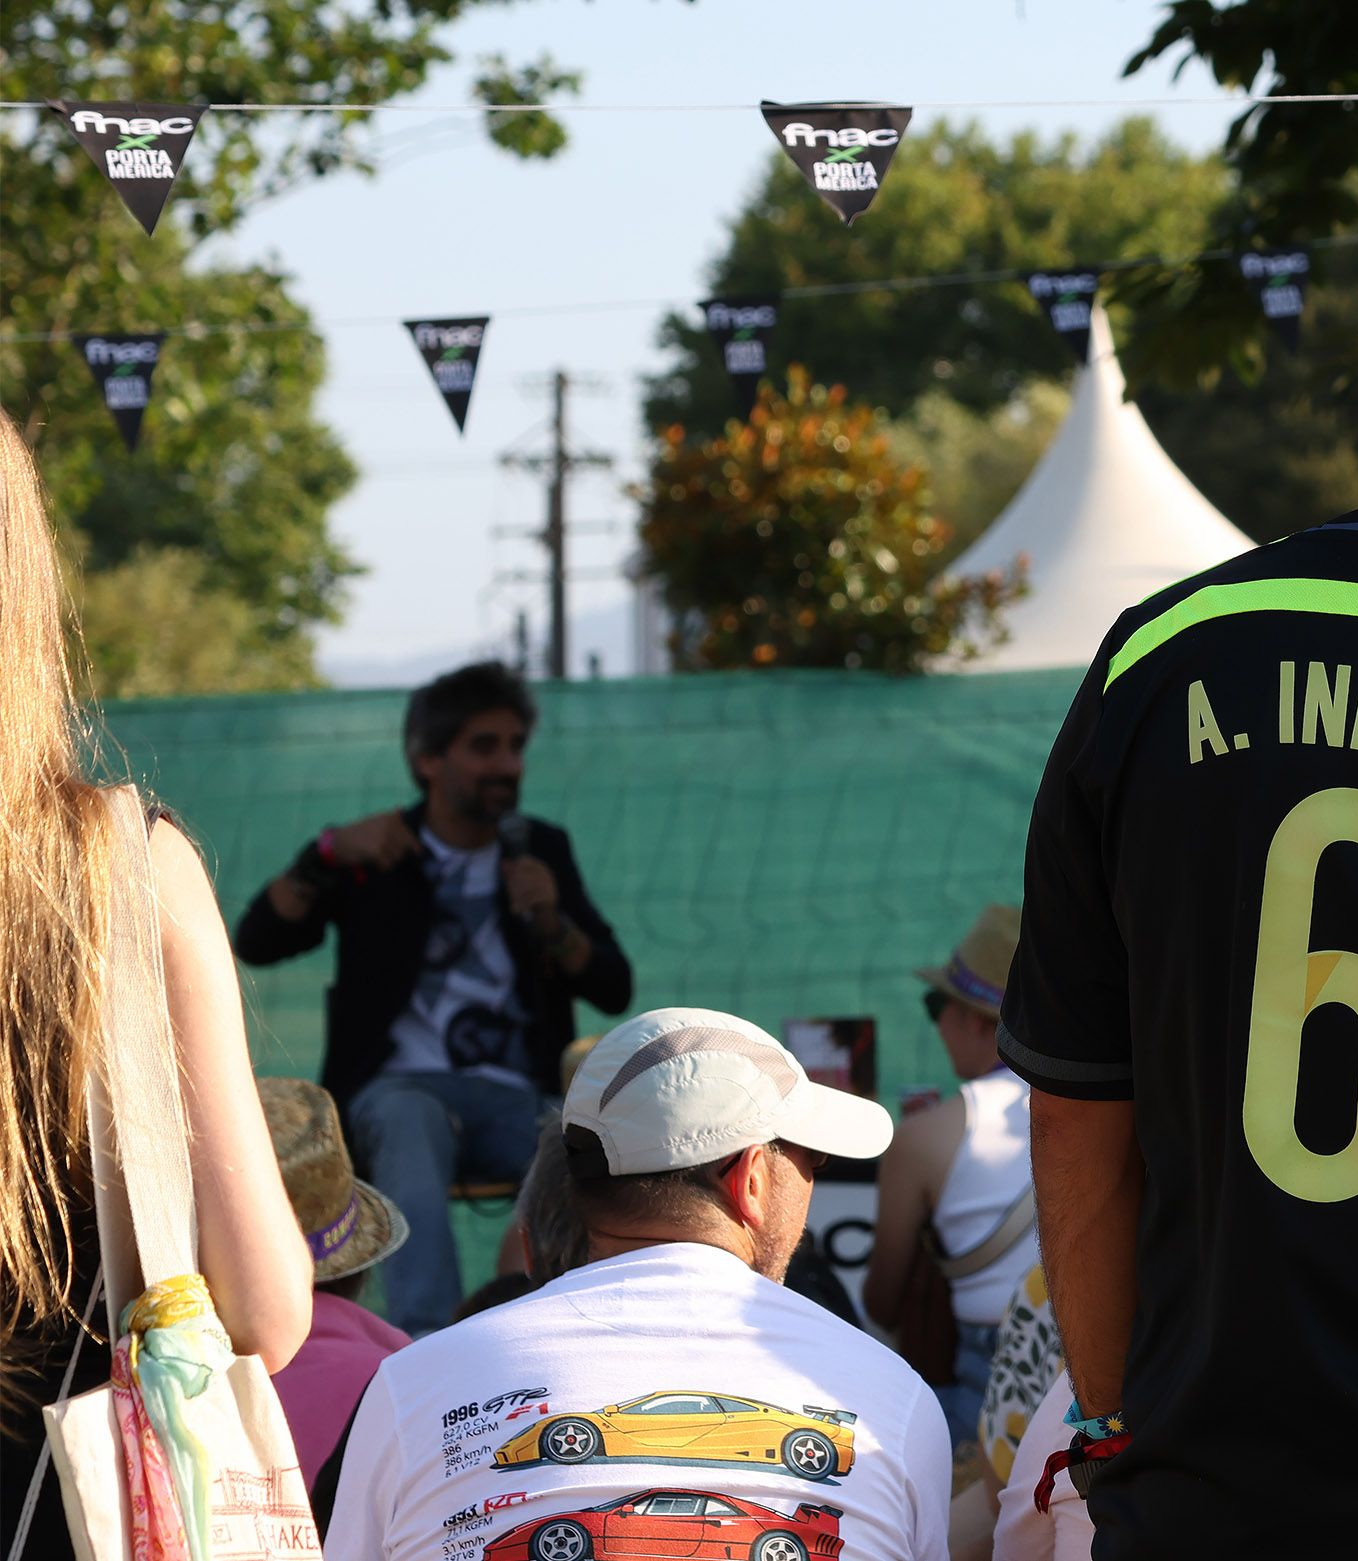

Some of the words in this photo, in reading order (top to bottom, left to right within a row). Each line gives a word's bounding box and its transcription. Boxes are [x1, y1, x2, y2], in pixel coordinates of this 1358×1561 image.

[70, 111, 194, 135] fnac
[782, 122, 899, 147] fnac
[105, 149, 173, 167] PORTA
[813, 161, 877, 178] PORTA
[1188, 680, 1250, 764] A.
[442, 1402, 479, 1428] 1996
[473, 1416, 489, 1427] CV
[466, 1422, 499, 1439] KGFM
[442, 1443, 462, 1459] 386
[444, 1454, 463, 1469] 386
[464, 1445, 492, 1460] km/h
[465, 1517, 493, 1533] KGFM
[458, 1536, 486, 1550] km/h
